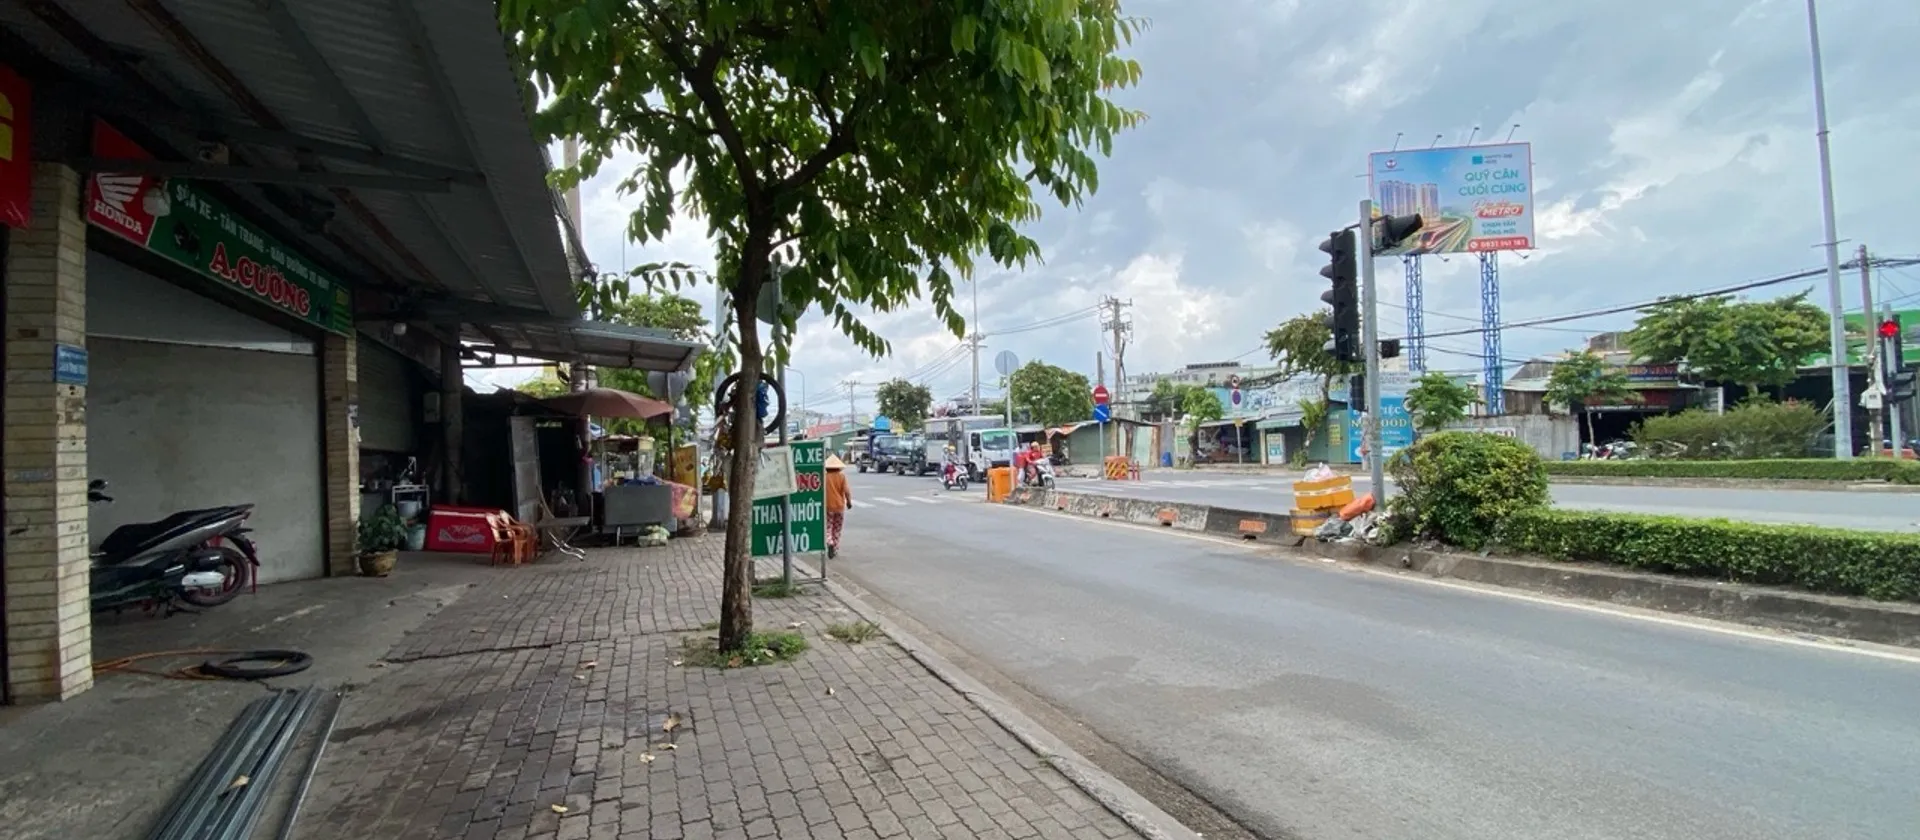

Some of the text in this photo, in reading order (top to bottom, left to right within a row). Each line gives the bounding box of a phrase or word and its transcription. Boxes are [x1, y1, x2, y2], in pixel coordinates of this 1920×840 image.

[1465, 168, 1490, 181] QUỸ
[1458, 182, 1489, 196] CUỐI
[94, 199, 144, 235] HONDA
[1482, 207, 1519, 216] METRO
[199, 199, 212, 220] XE
[238, 224, 264, 253] TRANG
[807, 448, 823, 462] XE
[753, 497, 822, 525] THAY NHỚT
[766, 527, 809, 554] VÁ VỎ
